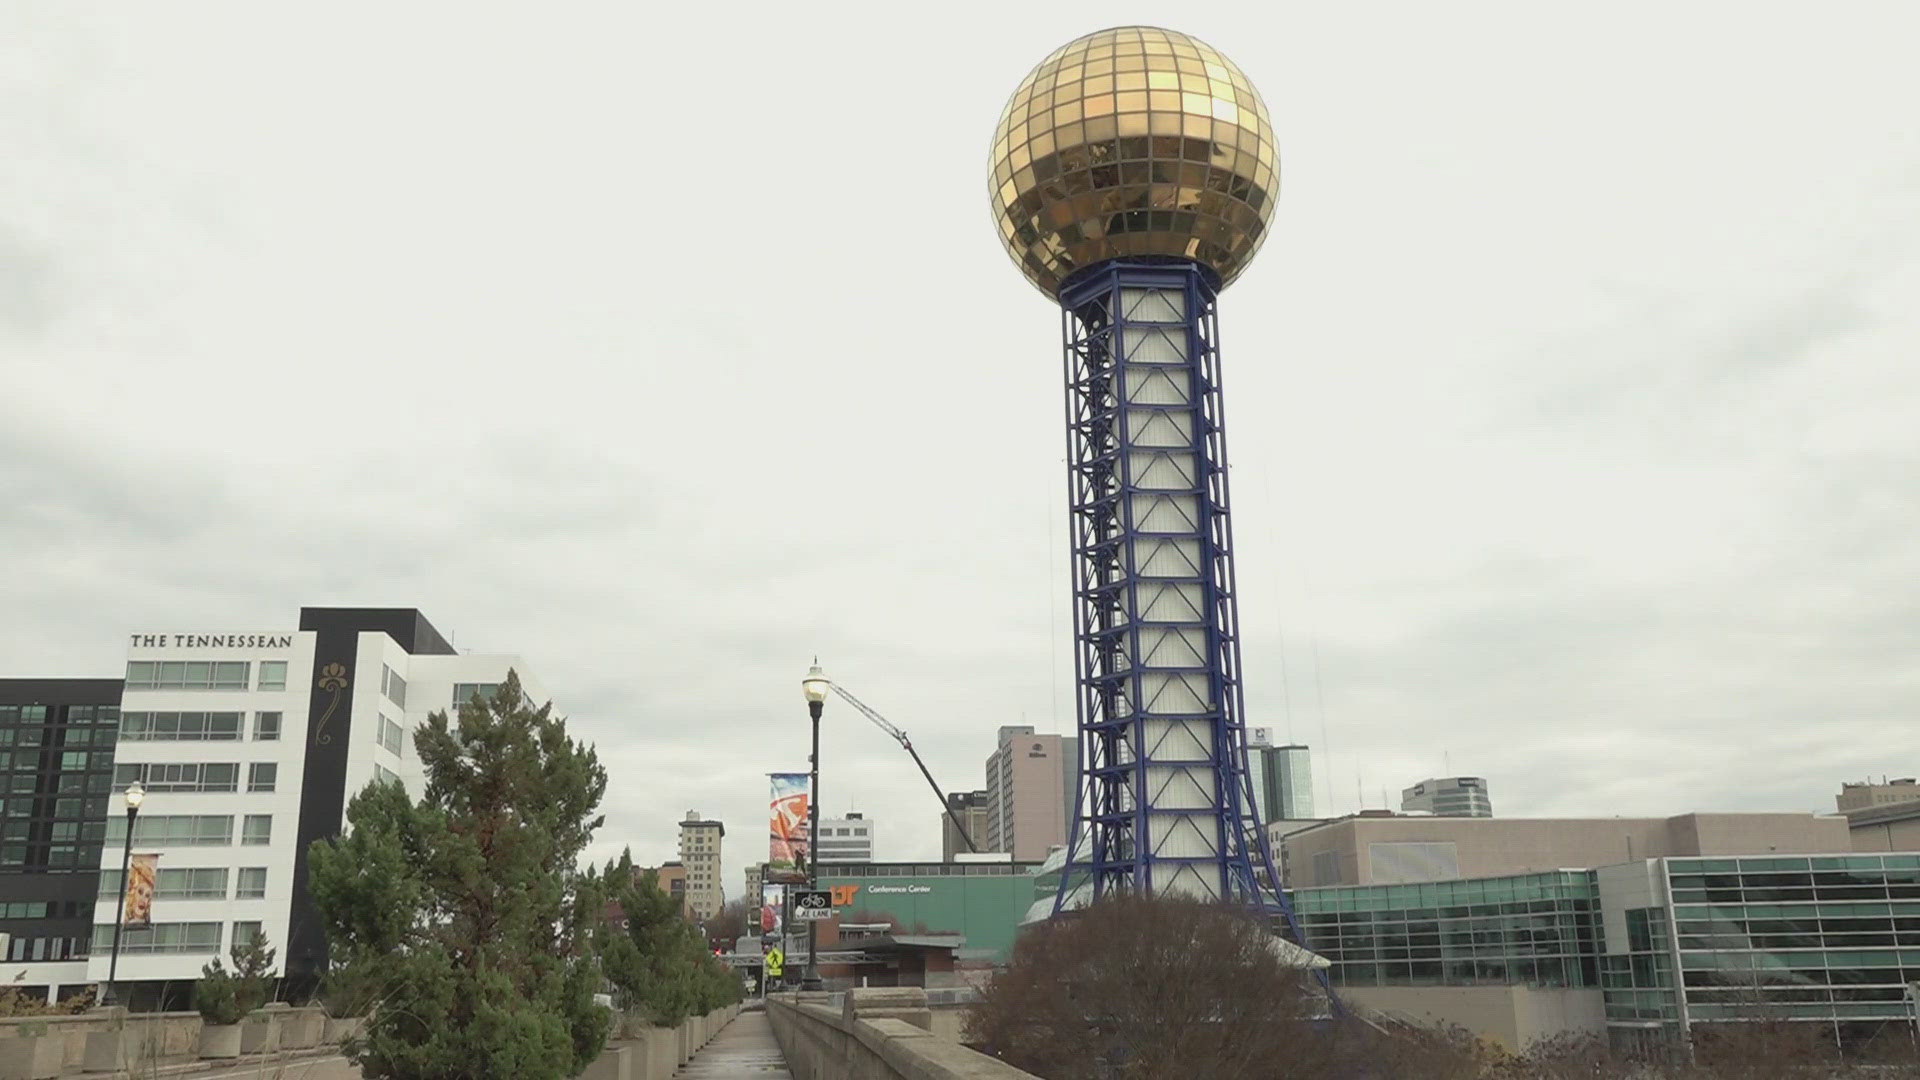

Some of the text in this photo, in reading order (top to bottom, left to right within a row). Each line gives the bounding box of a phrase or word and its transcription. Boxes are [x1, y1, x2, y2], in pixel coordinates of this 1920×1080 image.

[131, 635, 292, 648] THE TENNESSEAN
[868, 884, 931, 893] Conference Center
